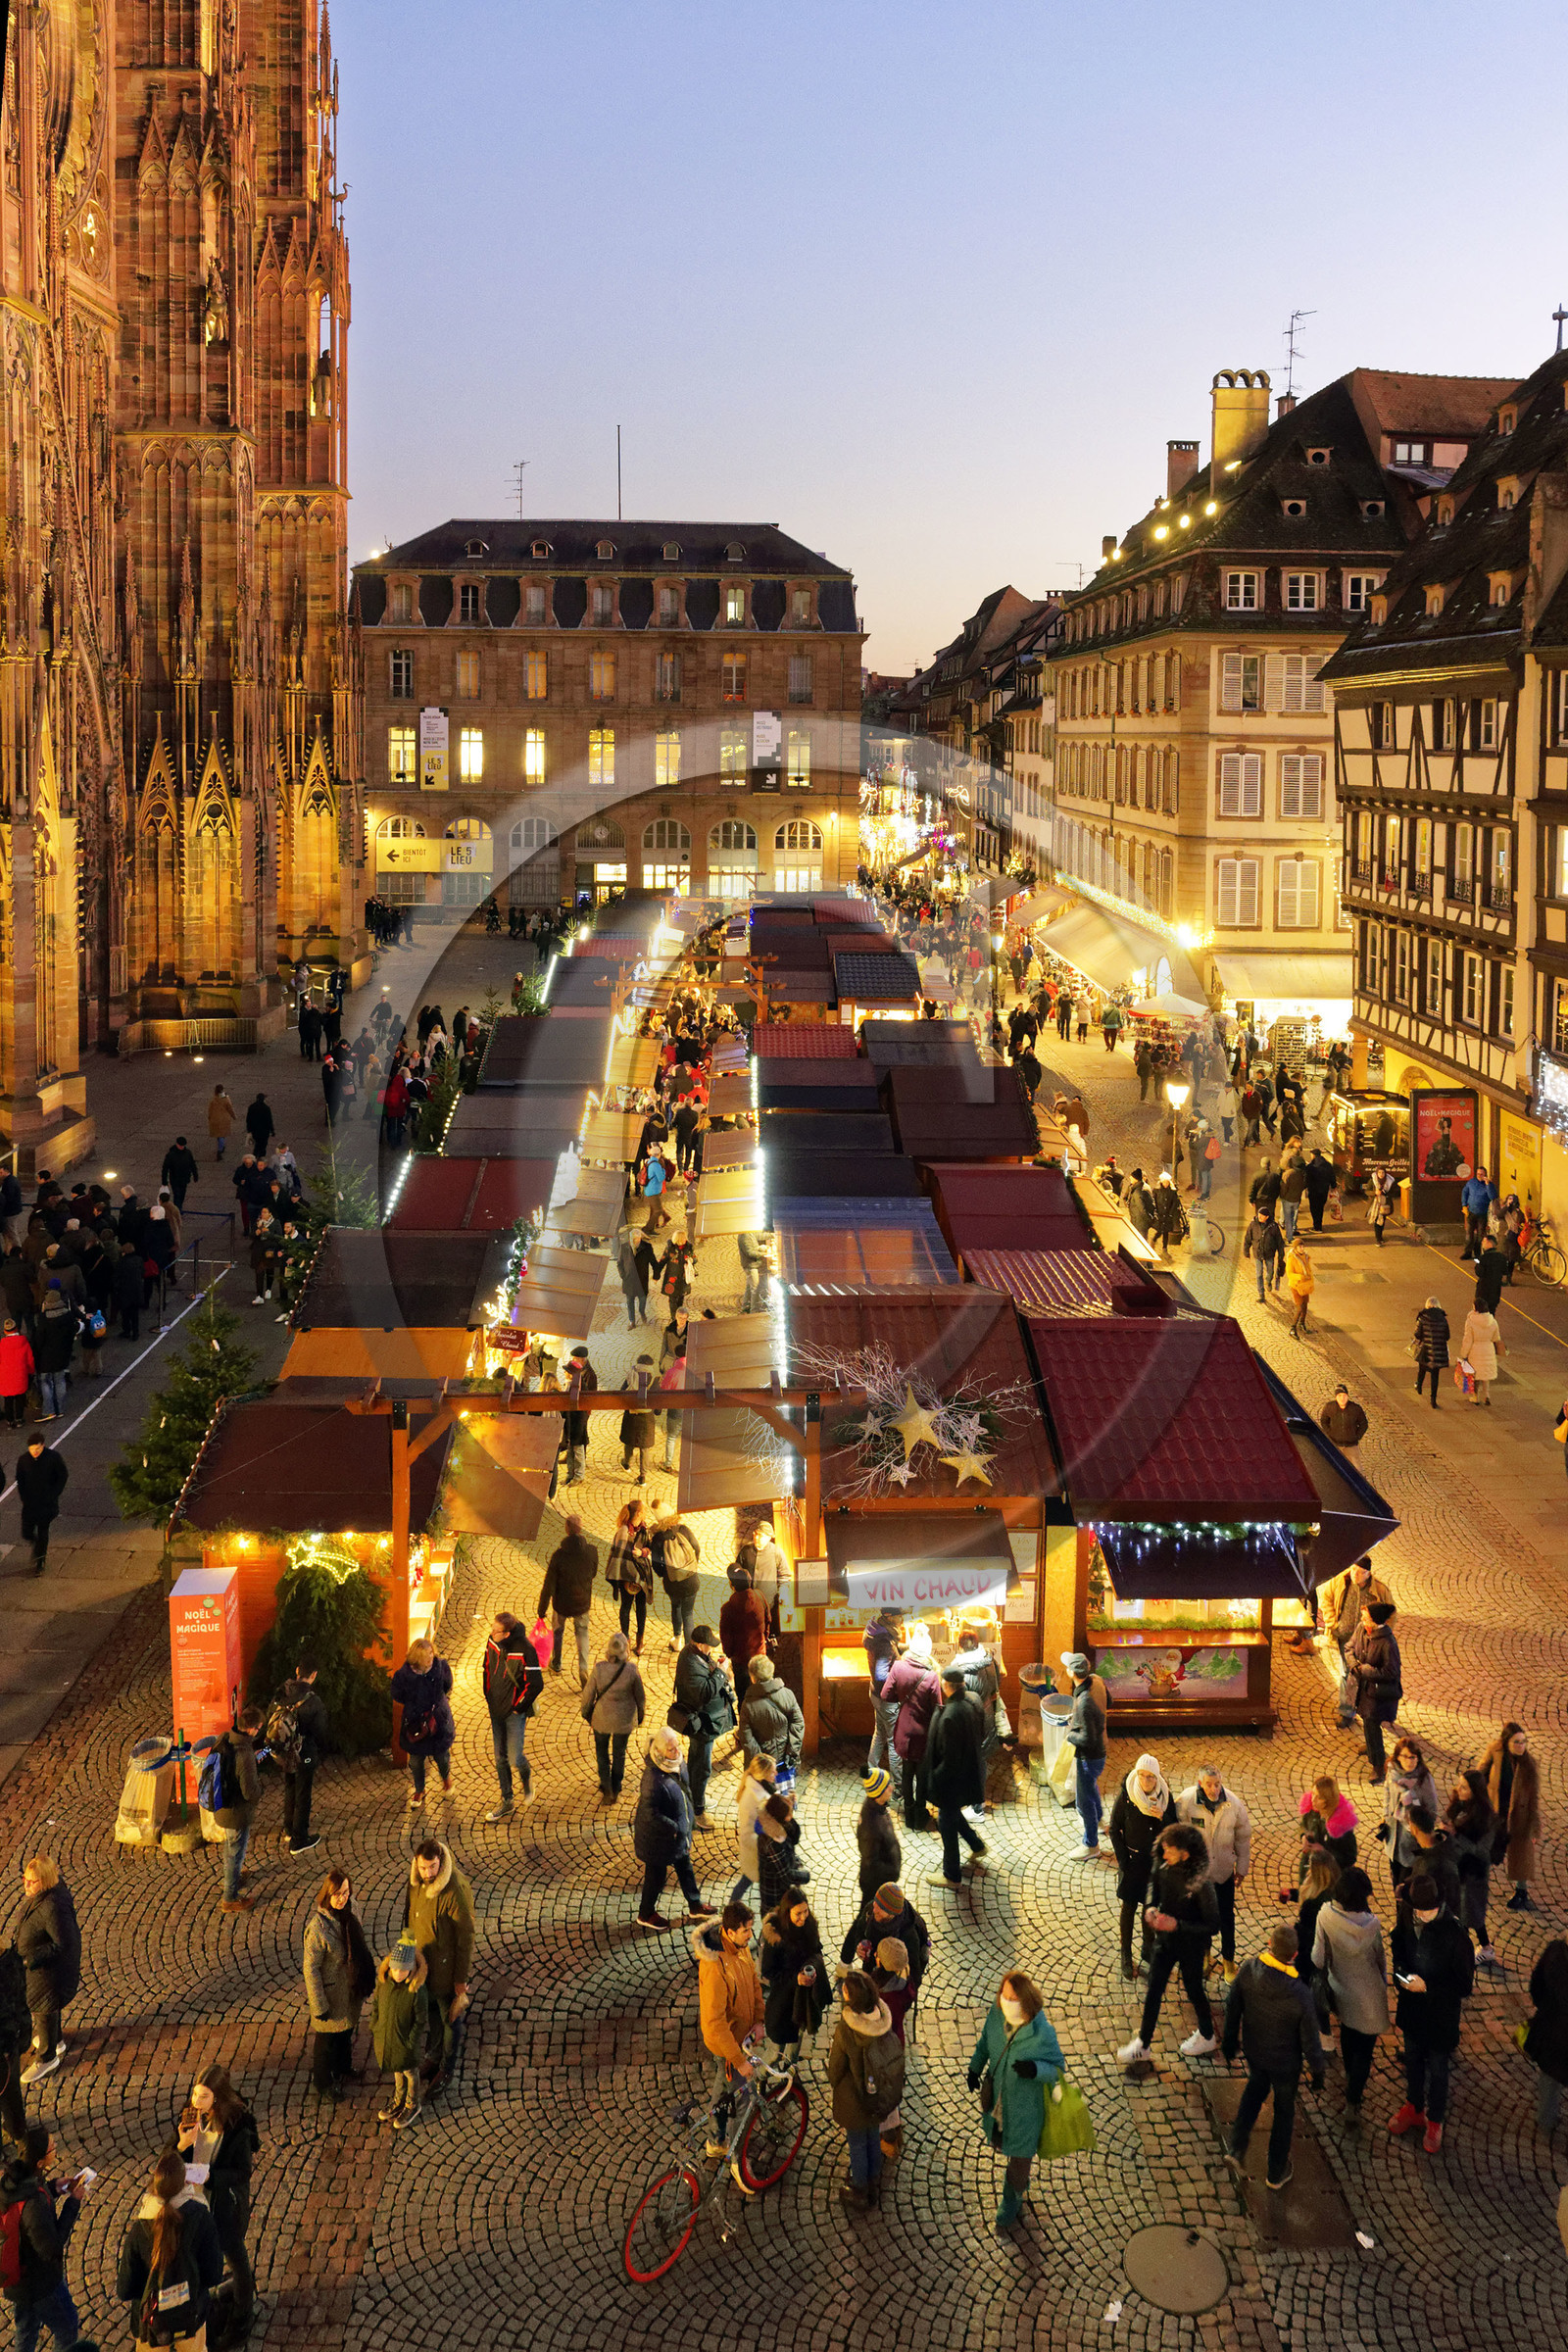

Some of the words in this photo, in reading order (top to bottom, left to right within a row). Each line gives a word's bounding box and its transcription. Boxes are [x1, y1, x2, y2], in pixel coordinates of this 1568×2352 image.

[451, 847, 462, 856] LE
[451, 857, 472, 865] LIEU
[863, 1579, 905, 1602] VIN
[913, 1572, 992, 1600] CHAUD
[184, 1608, 211, 1620] NOËL
[176, 1623, 220, 1634] MAGIQUE
